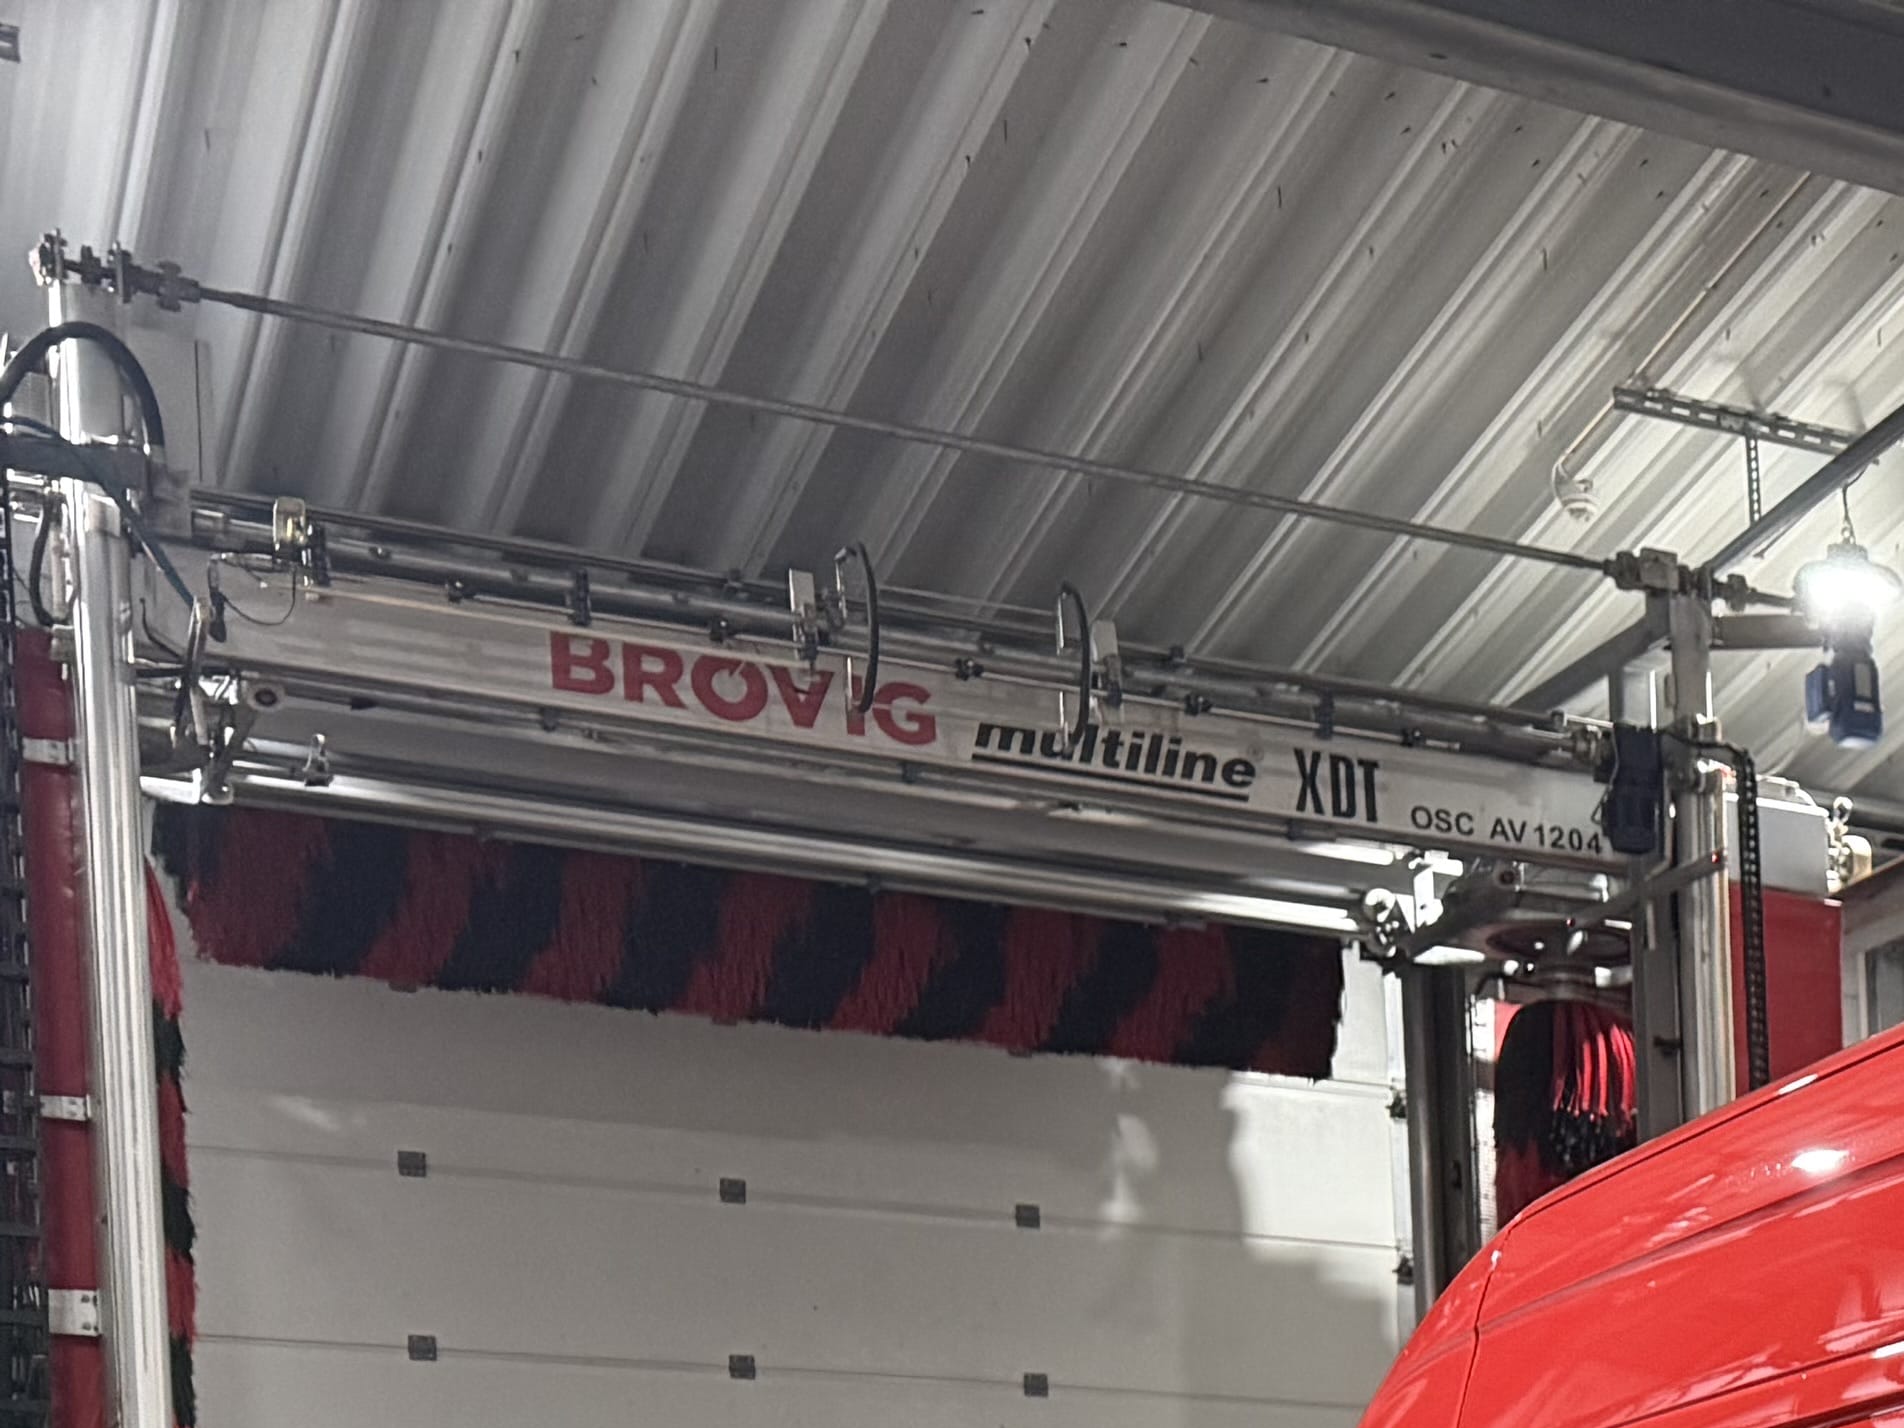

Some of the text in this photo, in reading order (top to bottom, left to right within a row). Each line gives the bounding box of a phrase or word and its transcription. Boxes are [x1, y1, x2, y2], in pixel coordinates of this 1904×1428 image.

[974, 721, 1257, 790] multiline
[1293, 747, 1380, 823] XDT
[1410, 806, 1475, 837] OSC
